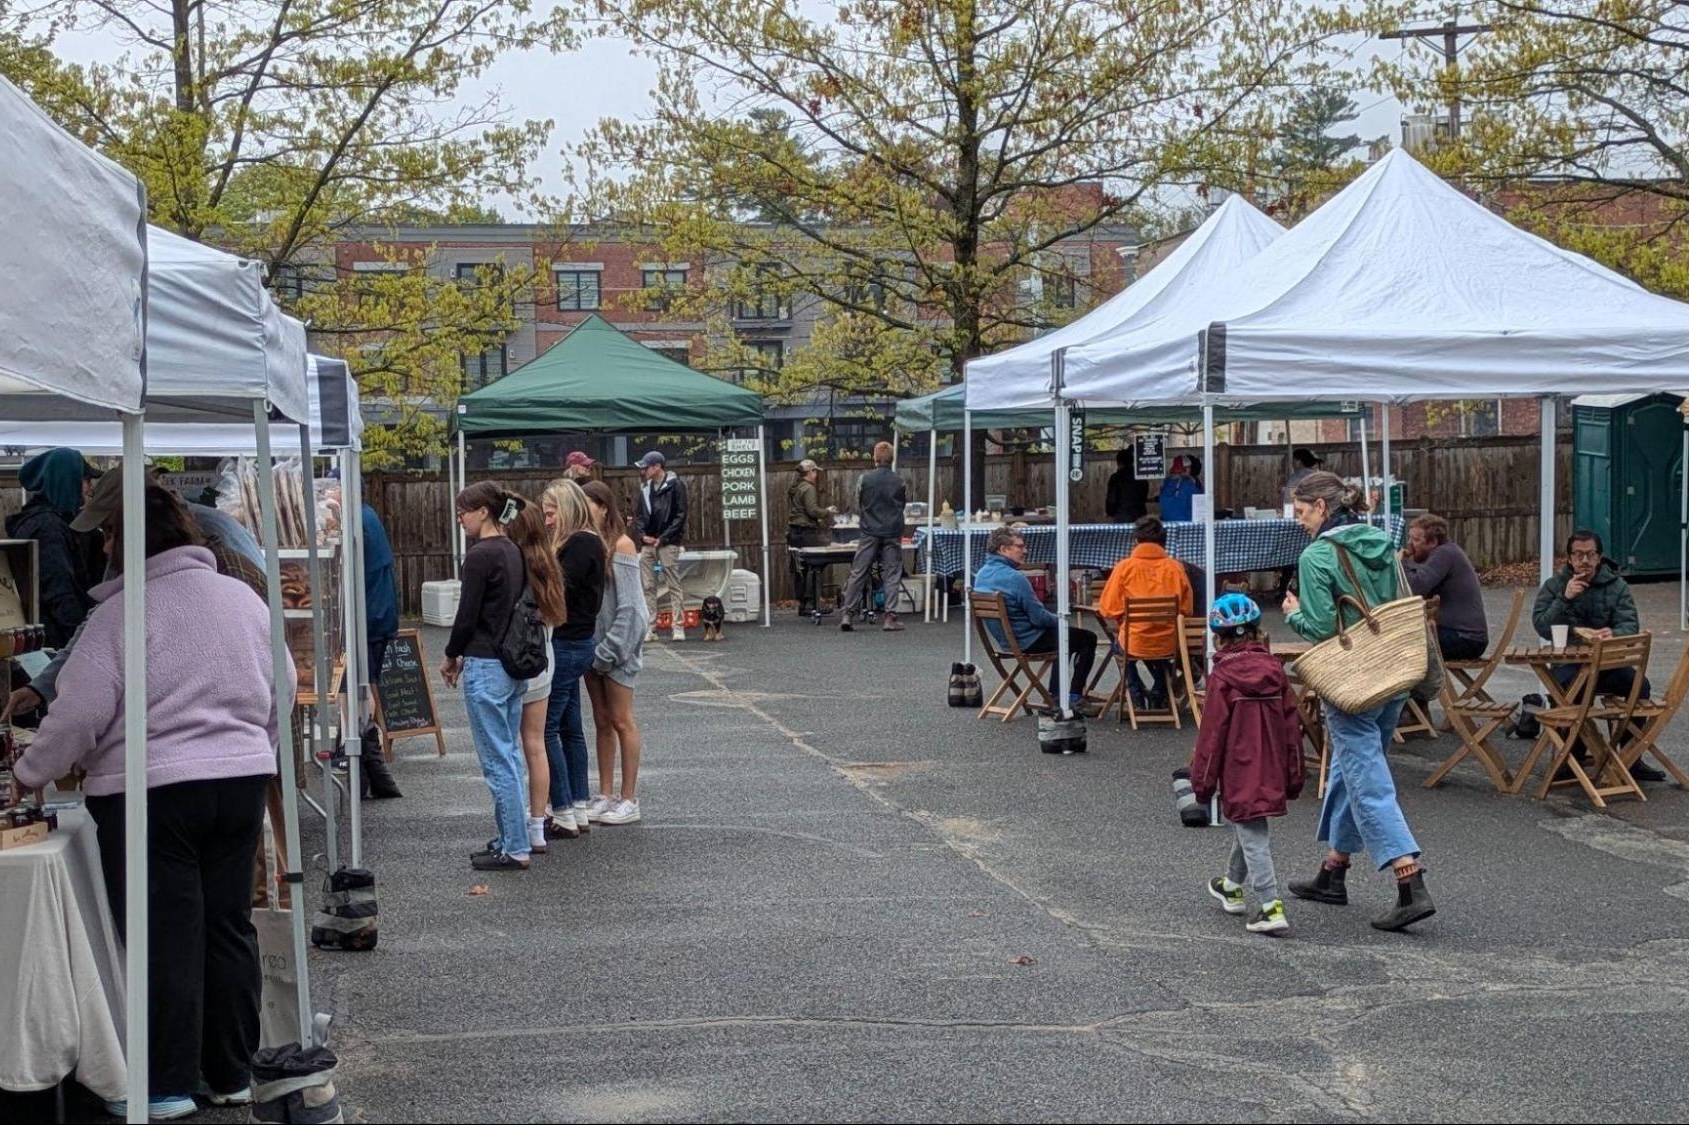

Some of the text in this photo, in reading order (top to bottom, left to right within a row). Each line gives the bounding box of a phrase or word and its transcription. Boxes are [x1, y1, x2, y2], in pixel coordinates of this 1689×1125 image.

[1071, 417, 1082, 453] SNAP
[721, 454, 755, 464] EGGS
[721, 468, 756, 478] CHICKEN
[721, 481, 756, 491] PORK
[722, 495, 756, 505] LAMB
[723, 509, 756, 519] BEEF
